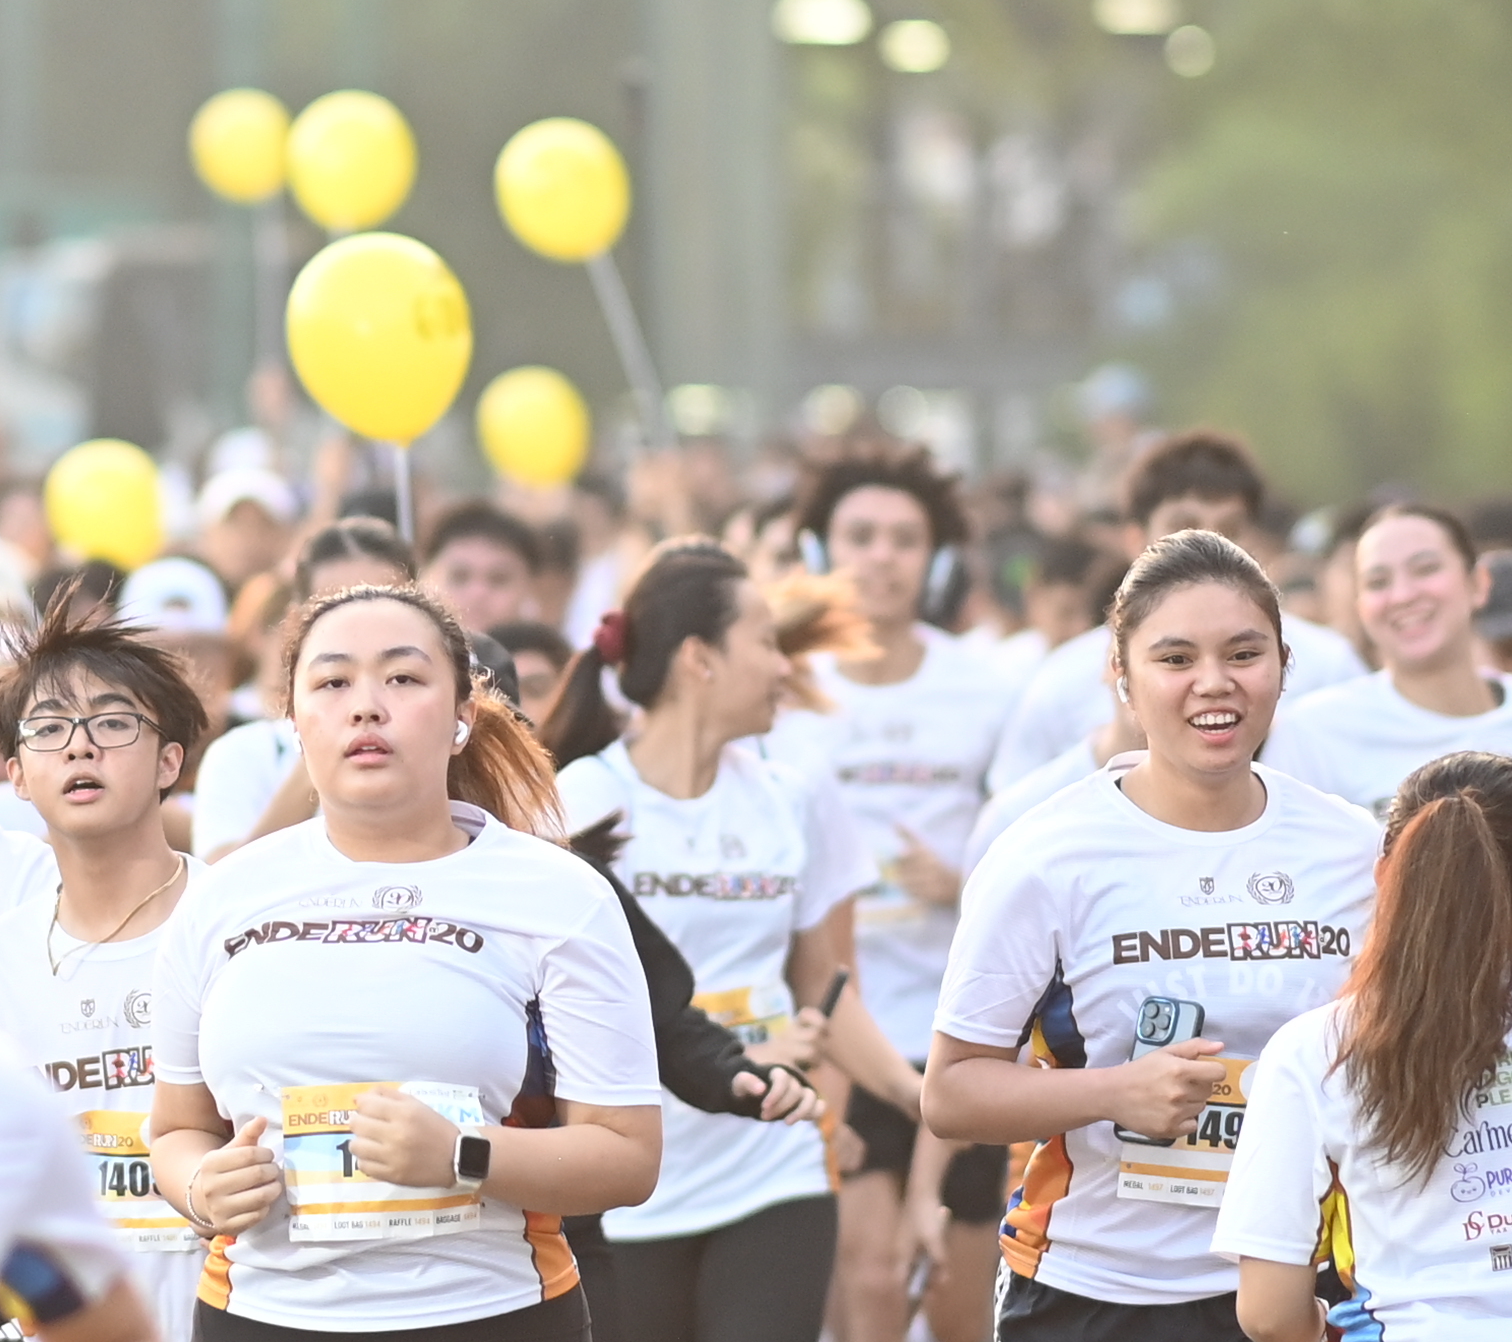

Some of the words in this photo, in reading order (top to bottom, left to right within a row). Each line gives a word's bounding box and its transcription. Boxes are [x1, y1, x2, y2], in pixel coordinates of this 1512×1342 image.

[98, 1160, 163, 1197] 140
[388, 1218, 412, 1227] RAFFLE
[1490, 1227, 1508, 1236] TAX
